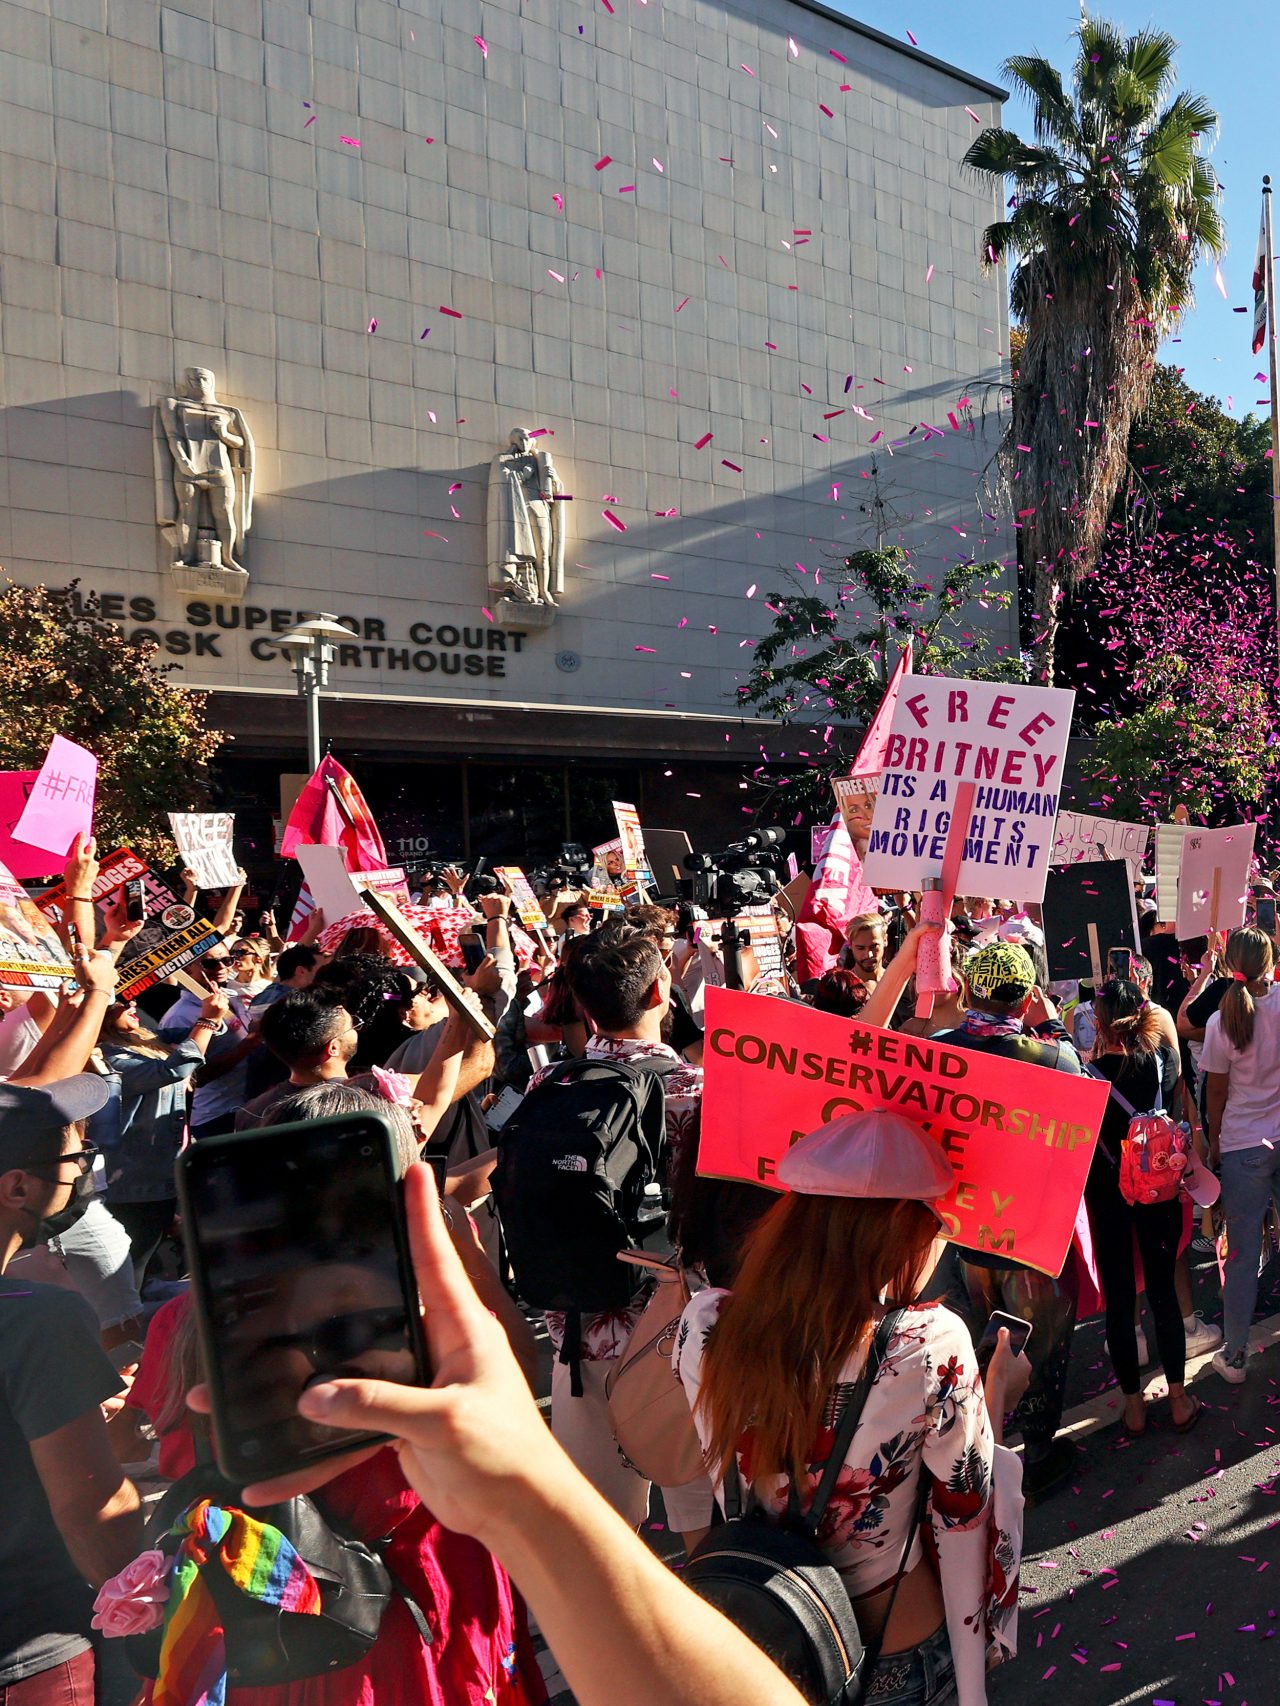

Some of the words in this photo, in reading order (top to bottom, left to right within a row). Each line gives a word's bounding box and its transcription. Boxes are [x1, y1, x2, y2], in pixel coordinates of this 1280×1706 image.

[251, 637, 506, 677] CRTHOUSE
[409, 622, 527, 653] COURT
[904, 690, 1056, 747] FREE
[883, 734, 1058, 788] BRITNEY
[837, 780, 865, 796] FREE
[882, 773, 917, 797] ITS
[929, 779, 947, 801] A
[976, 786, 1058, 817] HUMAN
[174, 813, 229, 850] FREE
[395, 837, 429, 851] 110
[894, 807, 1026, 844] RIGHTS
[868, 830, 1040, 868] MOVEMENT
[91, 857, 144, 899] UDGES
[154, 937, 187, 962] THEM
[189, 920, 214, 944] ALL
[848, 1029, 969, 1080] #END
[709, 1028, 1093, 1152] CONSERVATORSHIP
